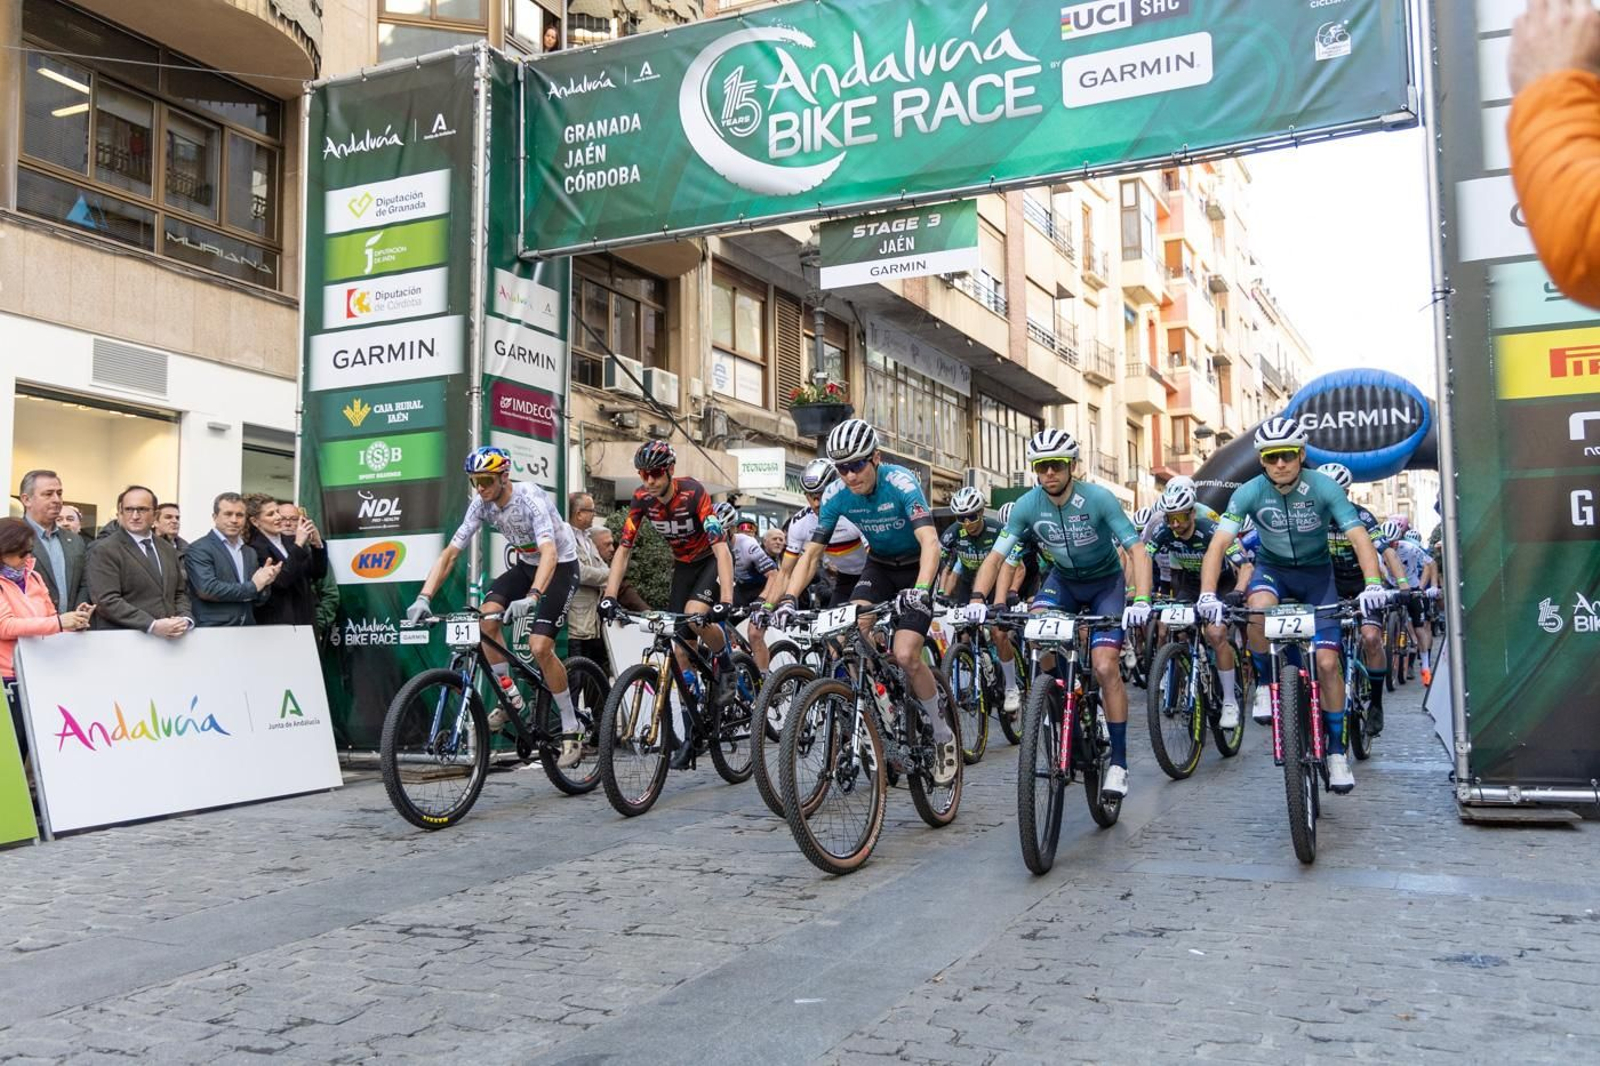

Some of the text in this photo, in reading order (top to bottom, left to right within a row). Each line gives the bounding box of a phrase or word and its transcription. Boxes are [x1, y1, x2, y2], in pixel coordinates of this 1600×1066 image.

[1073, 1, 1126, 31] UCI
[764, 3, 1042, 111] Andalucía
[1078, 51, 1196, 89] GARMIN
[547, 71, 616, 101] Andalucía
[768, 63, 1043, 160] BIKE RACE
[564, 113, 642, 145] GRANADA
[323, 124, 404, 160] Andalucía
[564, 144, 607, 169] JAÉN
[564, 164, 641, 195] CÓRDOBA
[375, 190, 424, 208] Diputación
[375, 200, 426, 218] de Granada
[852, 213, 942, 238] STAGE 3
[879, 235, 915, 255] JAÉN
[869, 260, 927, 276] GARMIN
[375, 286, 422, 301] Diputación
[332, 338, 436, 370] GARMIN
[494, 339, 556, 371] GARMIN
[373, 403, 394, 414] CAJA
[387, 412, 409, 424] JAÉN
[512, 398, 553, 420] IMDECO
[1301, 407, 1412, 431] GARMIN
[358, 497, 402, 519] NDL
[345, 617, 398, 634] Andalucía
[828, 607, 847, 627] 1-2
[1170, 609, 1186, 620] 2-1
[1277, 617, 1302, 634] 7-2
[455, 624, 470, 641] 9-1
[1038, 619, 1060, 635] 7-1
[345, 633, 368, 645] BIKE
[370, 633, 399, 645] RACE
[55, 695, 231, 752] Andalucía
[268, 722, 283, 731] Junta
[293, 718, 321, 728] Andalucía
